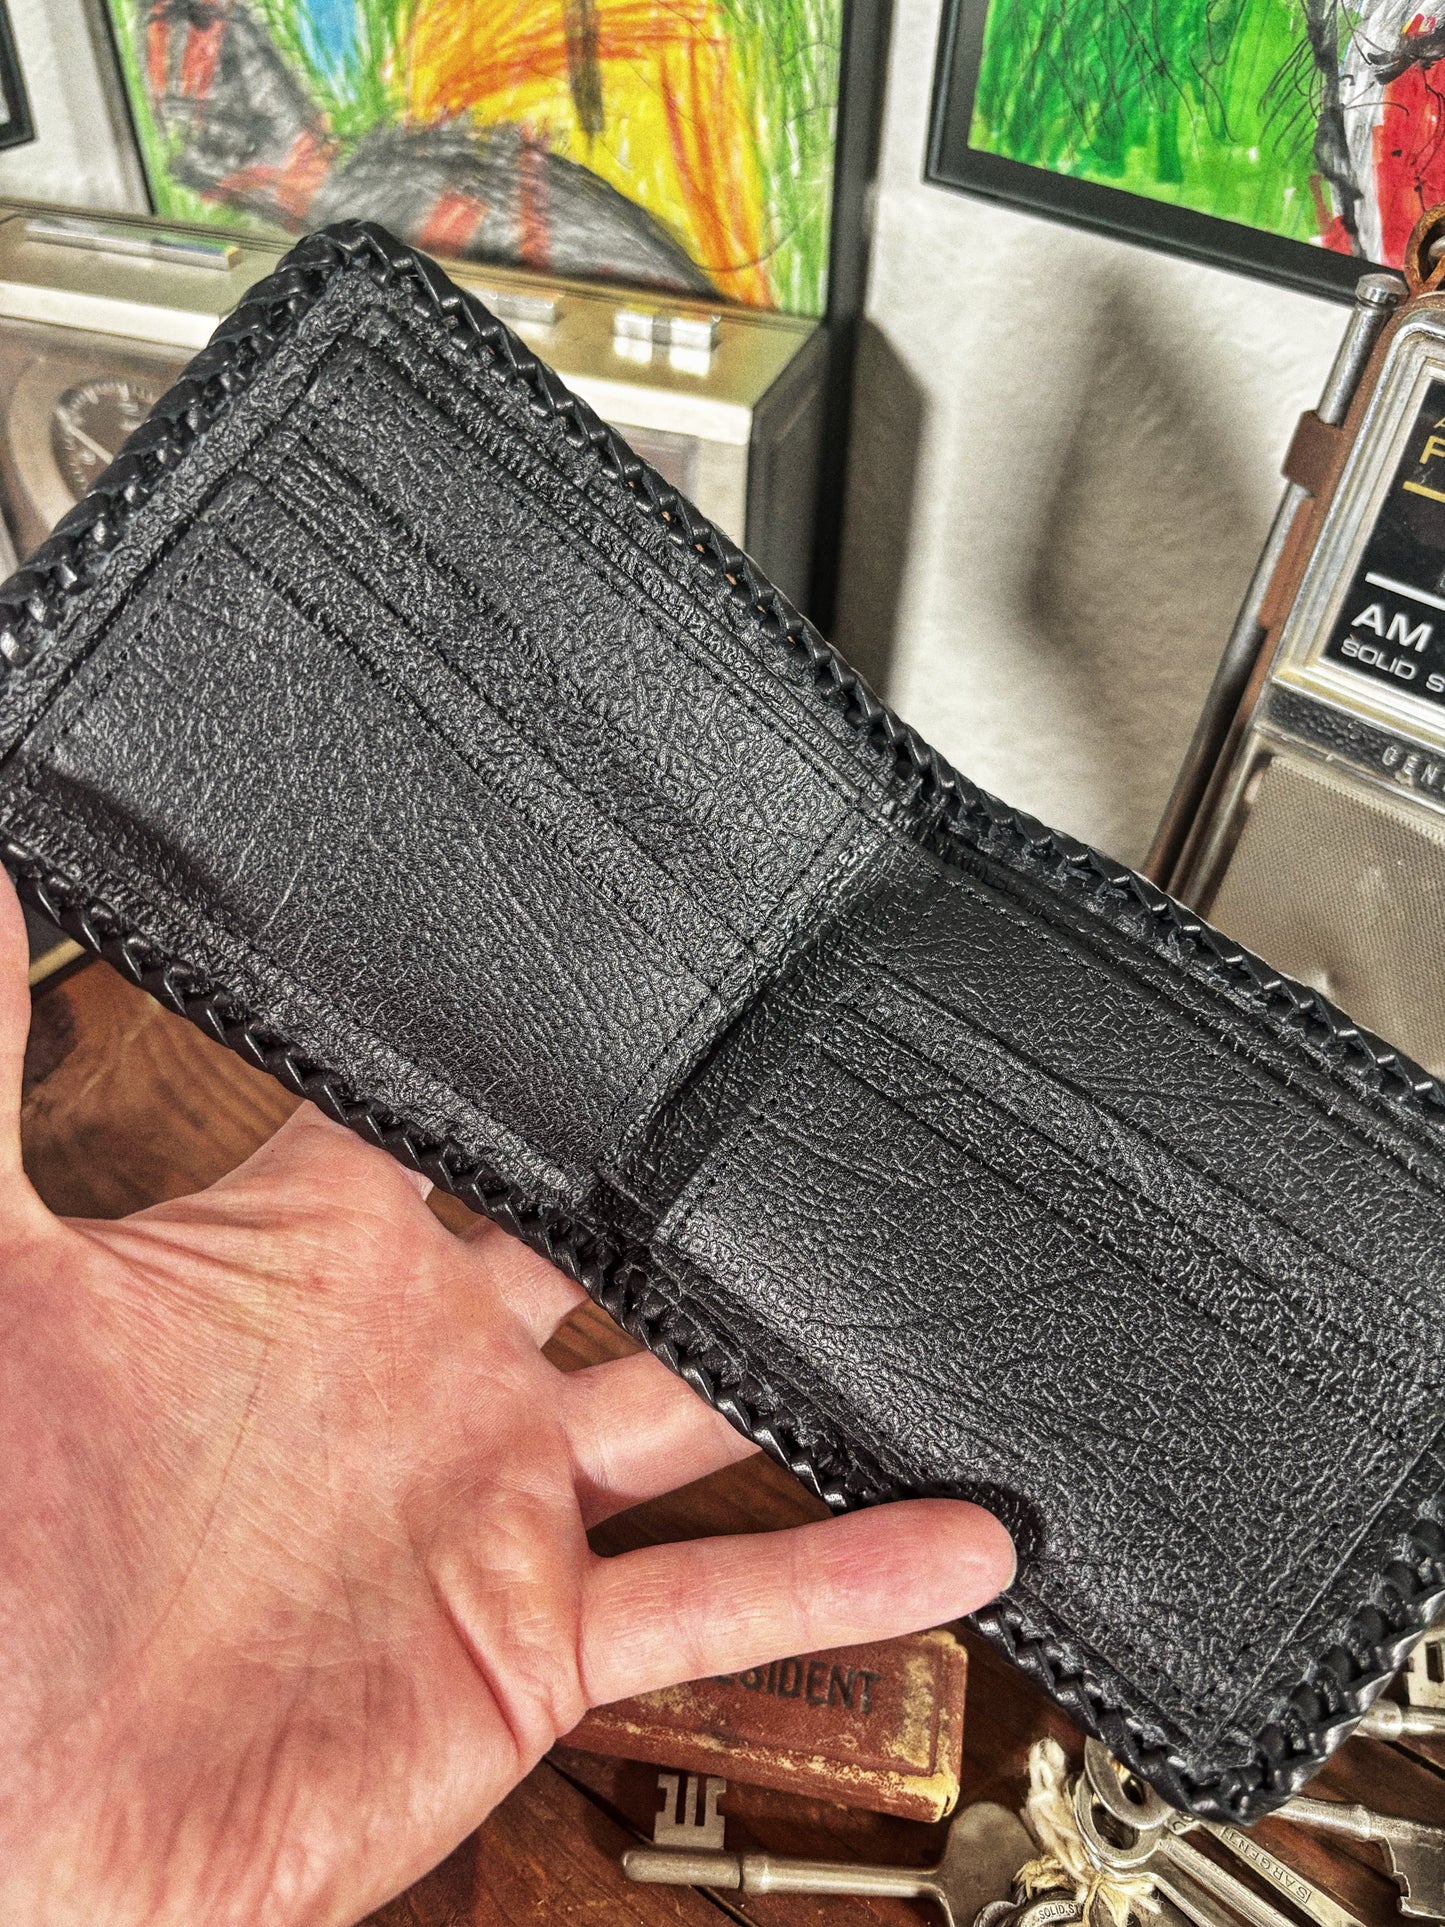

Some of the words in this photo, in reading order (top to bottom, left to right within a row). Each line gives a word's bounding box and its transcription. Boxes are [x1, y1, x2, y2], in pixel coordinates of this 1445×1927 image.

[1351, 603, 1434, 653] AM
[1341, 638, 1417, 680] SOLID
[1381, 745, 1445, 792] GEN
[706, 1656, 882, 1715] SIDENT
[1226, 1831, 1309, 1900] SARGENT
